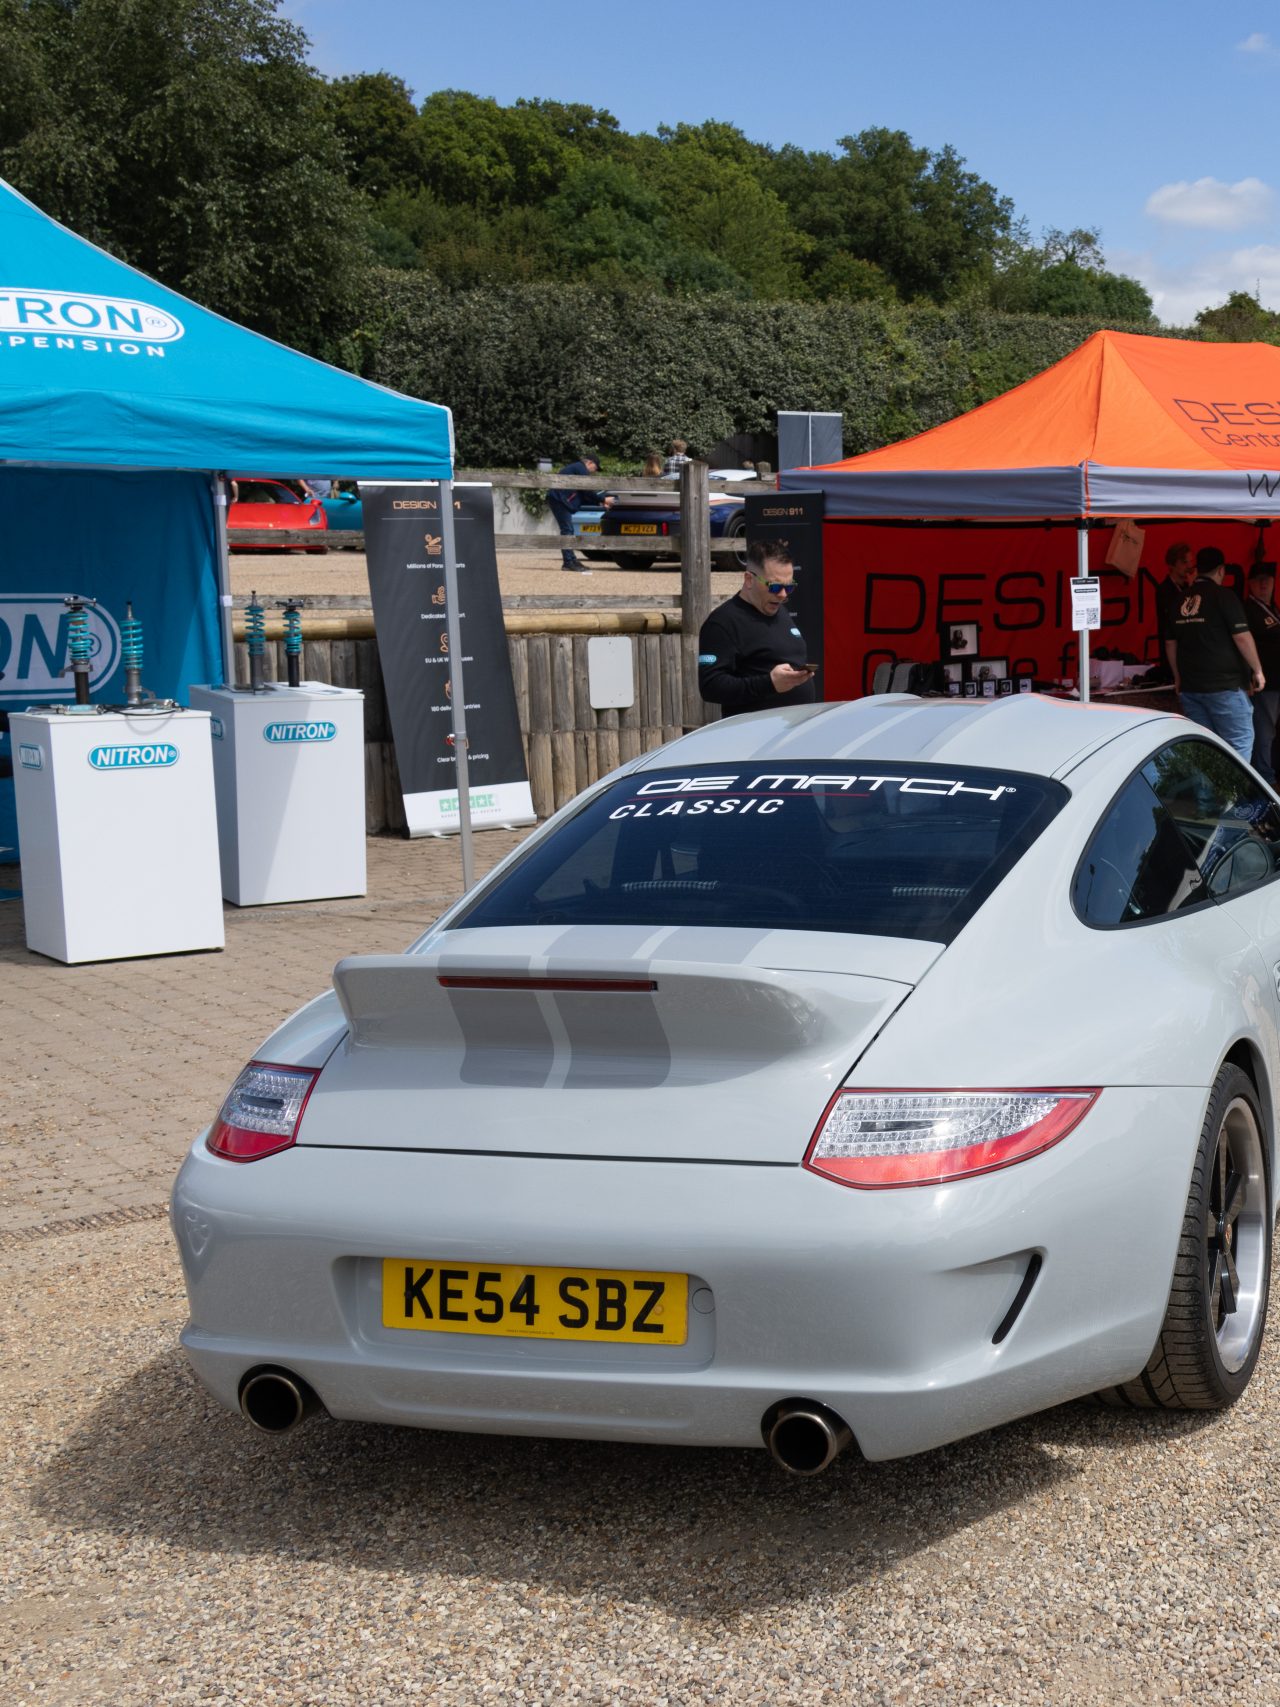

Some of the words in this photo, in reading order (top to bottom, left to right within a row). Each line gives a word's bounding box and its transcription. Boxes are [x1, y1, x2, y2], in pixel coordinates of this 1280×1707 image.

[0, 335, 165, 357] PENSION
[393, 500, 437, 510] DESIGN
[763, 508, 789, 516] DESIGN
[789, 507, 804, 516] 911
[271, 723, 329, 740] NITRON
[97, 746, 168, 766] NITRON
[472, 753, 489, 761] pricing
[609, 798, 785, 820] CLASSIC
[404, 1266, 540, 1326] KE54
[558, 1276, 665, 1334] SBZ
